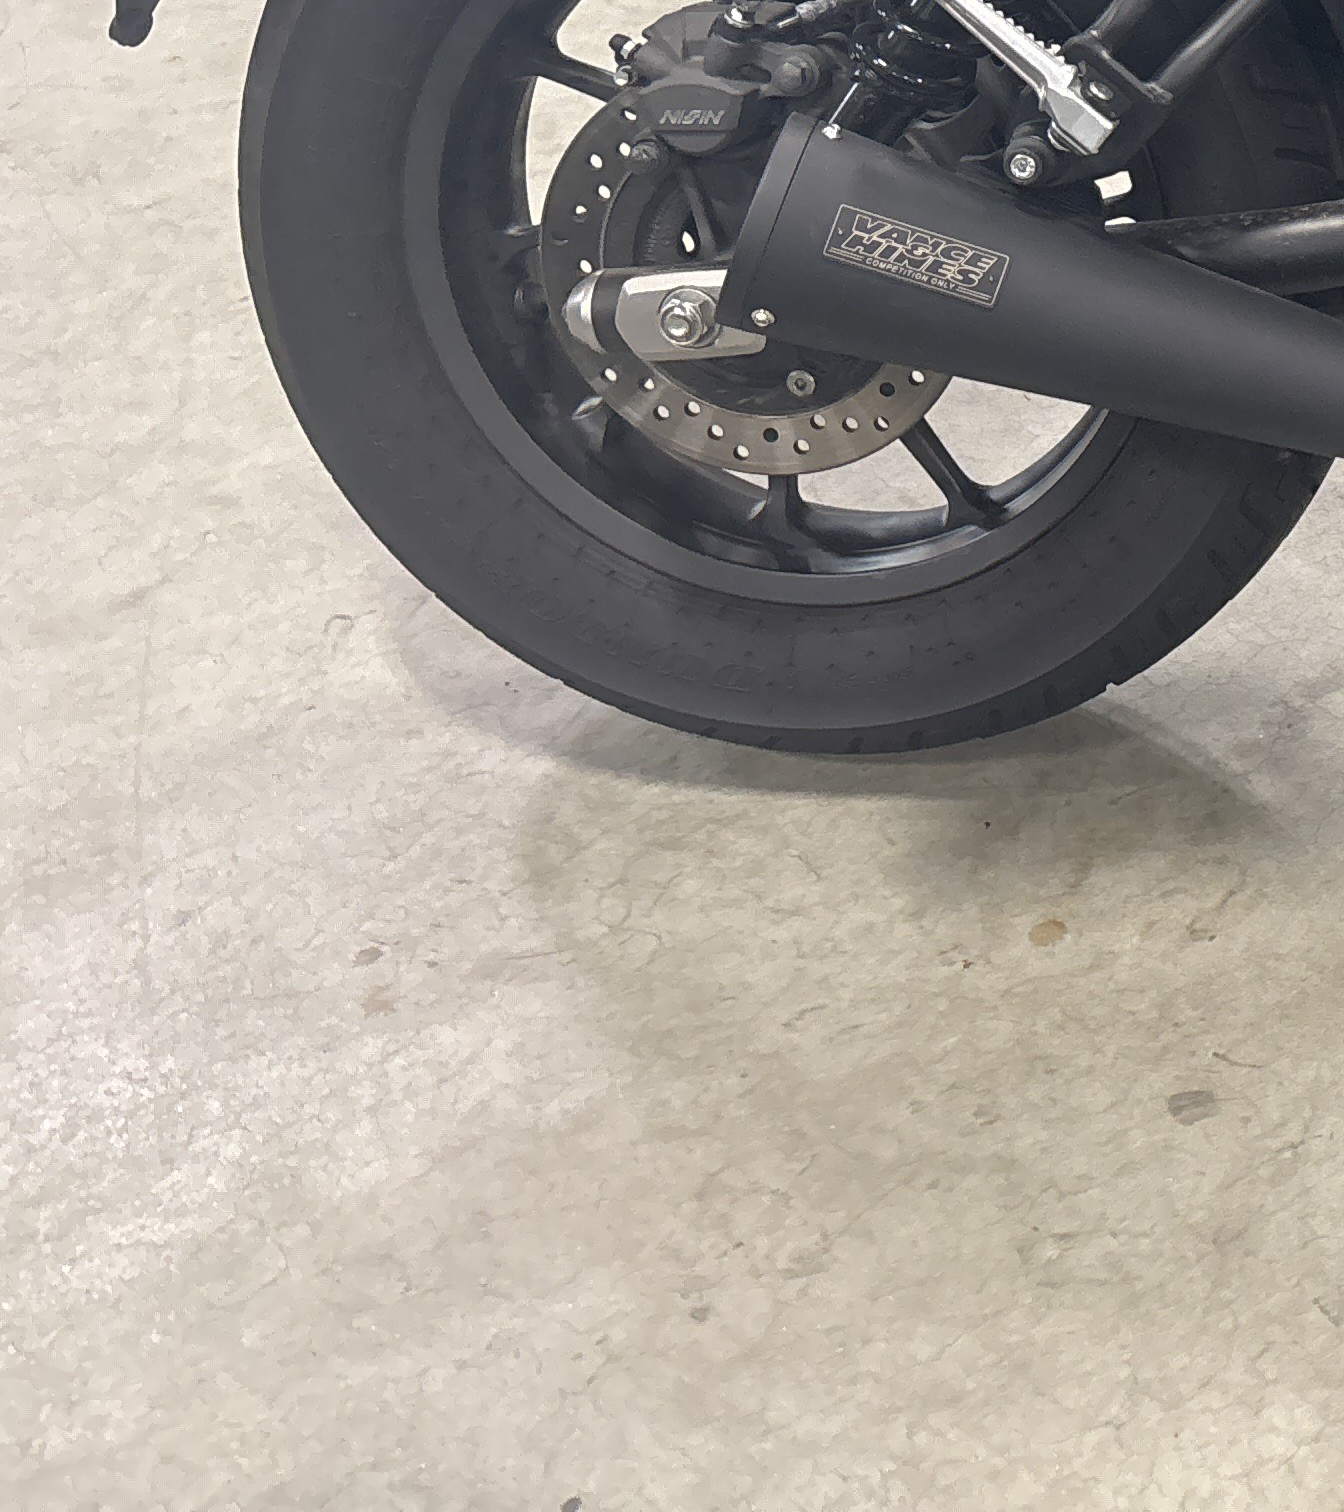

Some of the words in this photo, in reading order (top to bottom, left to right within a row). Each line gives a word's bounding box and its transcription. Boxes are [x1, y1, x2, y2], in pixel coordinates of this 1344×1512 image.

[841, 232, 983, 287] HINES
[852, 214, 998, 273] VANCE
[866, 257, 929, 284] COMPETITION
[931, 277, 956, 290] ONLY
